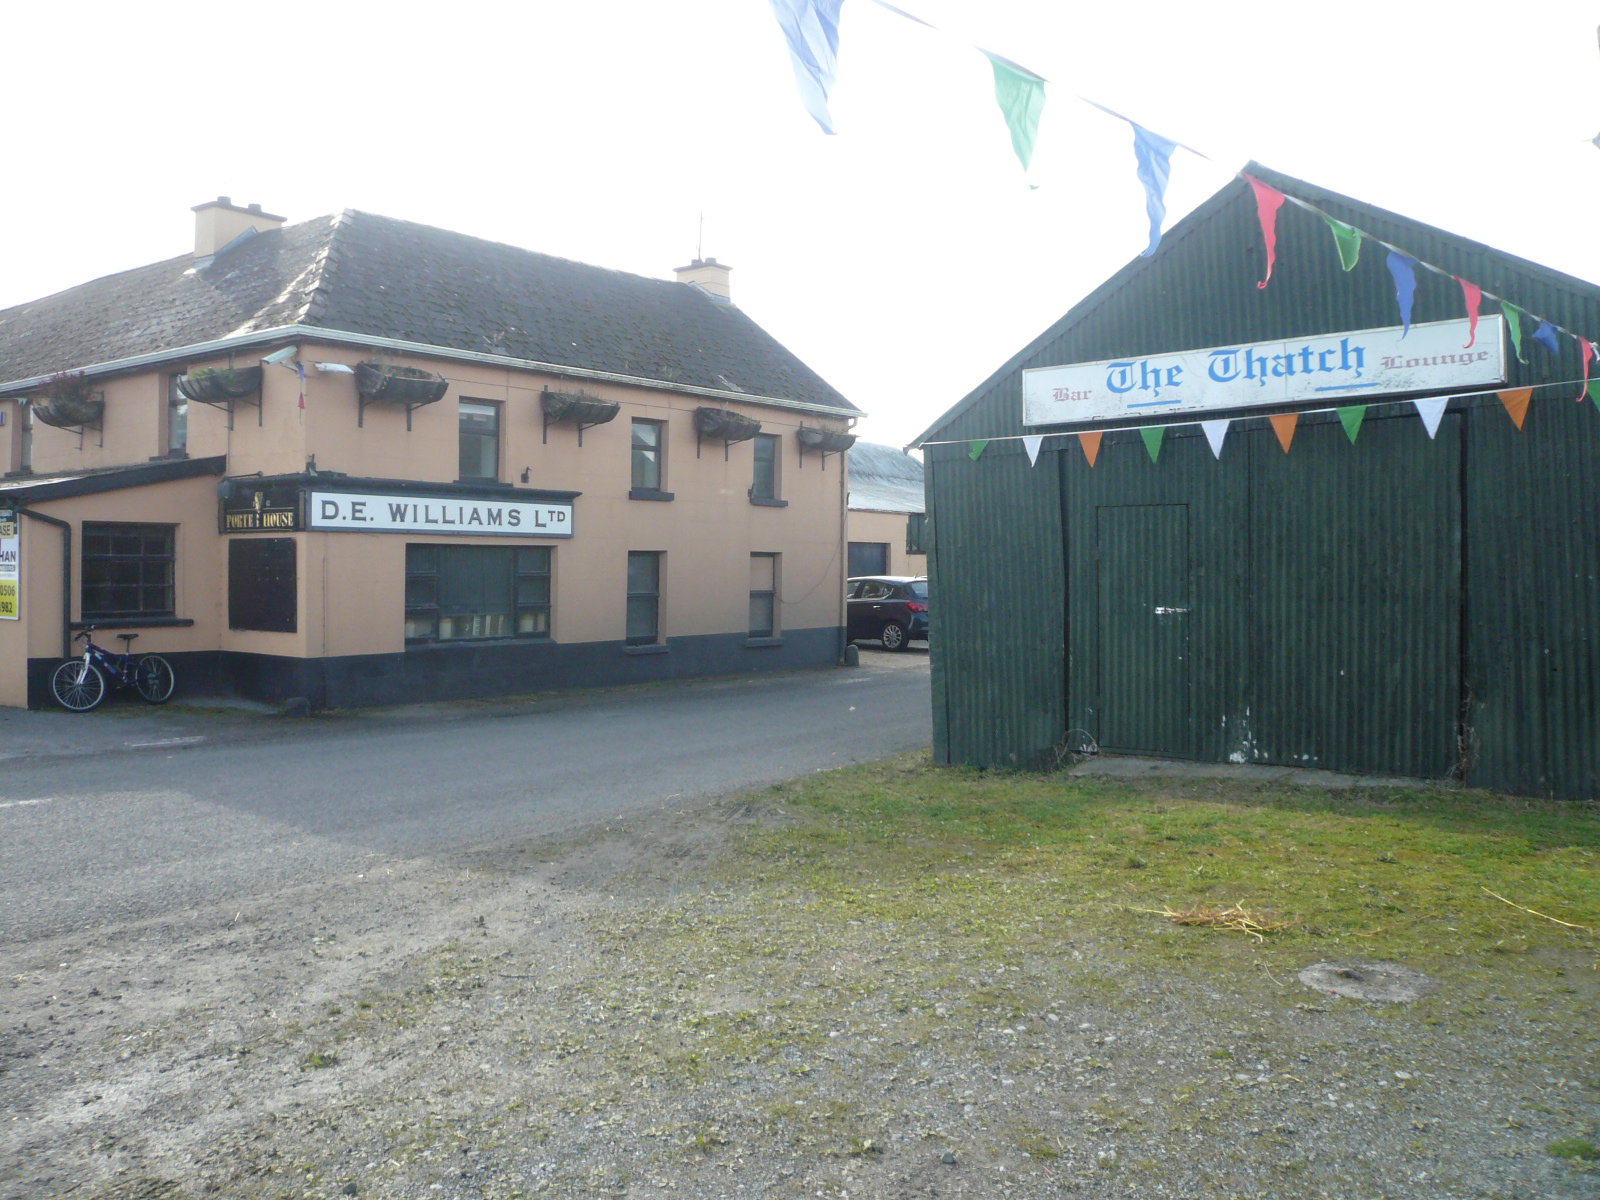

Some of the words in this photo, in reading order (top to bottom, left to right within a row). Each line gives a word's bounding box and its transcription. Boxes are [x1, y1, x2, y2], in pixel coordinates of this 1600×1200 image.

[1052, 387, 1092, 402] Bar
[1106, 359, 1184, 398] The
[1207, 337, 1366, 387] Thatch
[1380, 350, 1489, 370] Lounge
[263, 511, 294, 527] HOUSE
[321, 500, 374, 521] D.E.
[388, 503, 521, 527] WILLIAMS
[0, 601, 12, 614] 982
